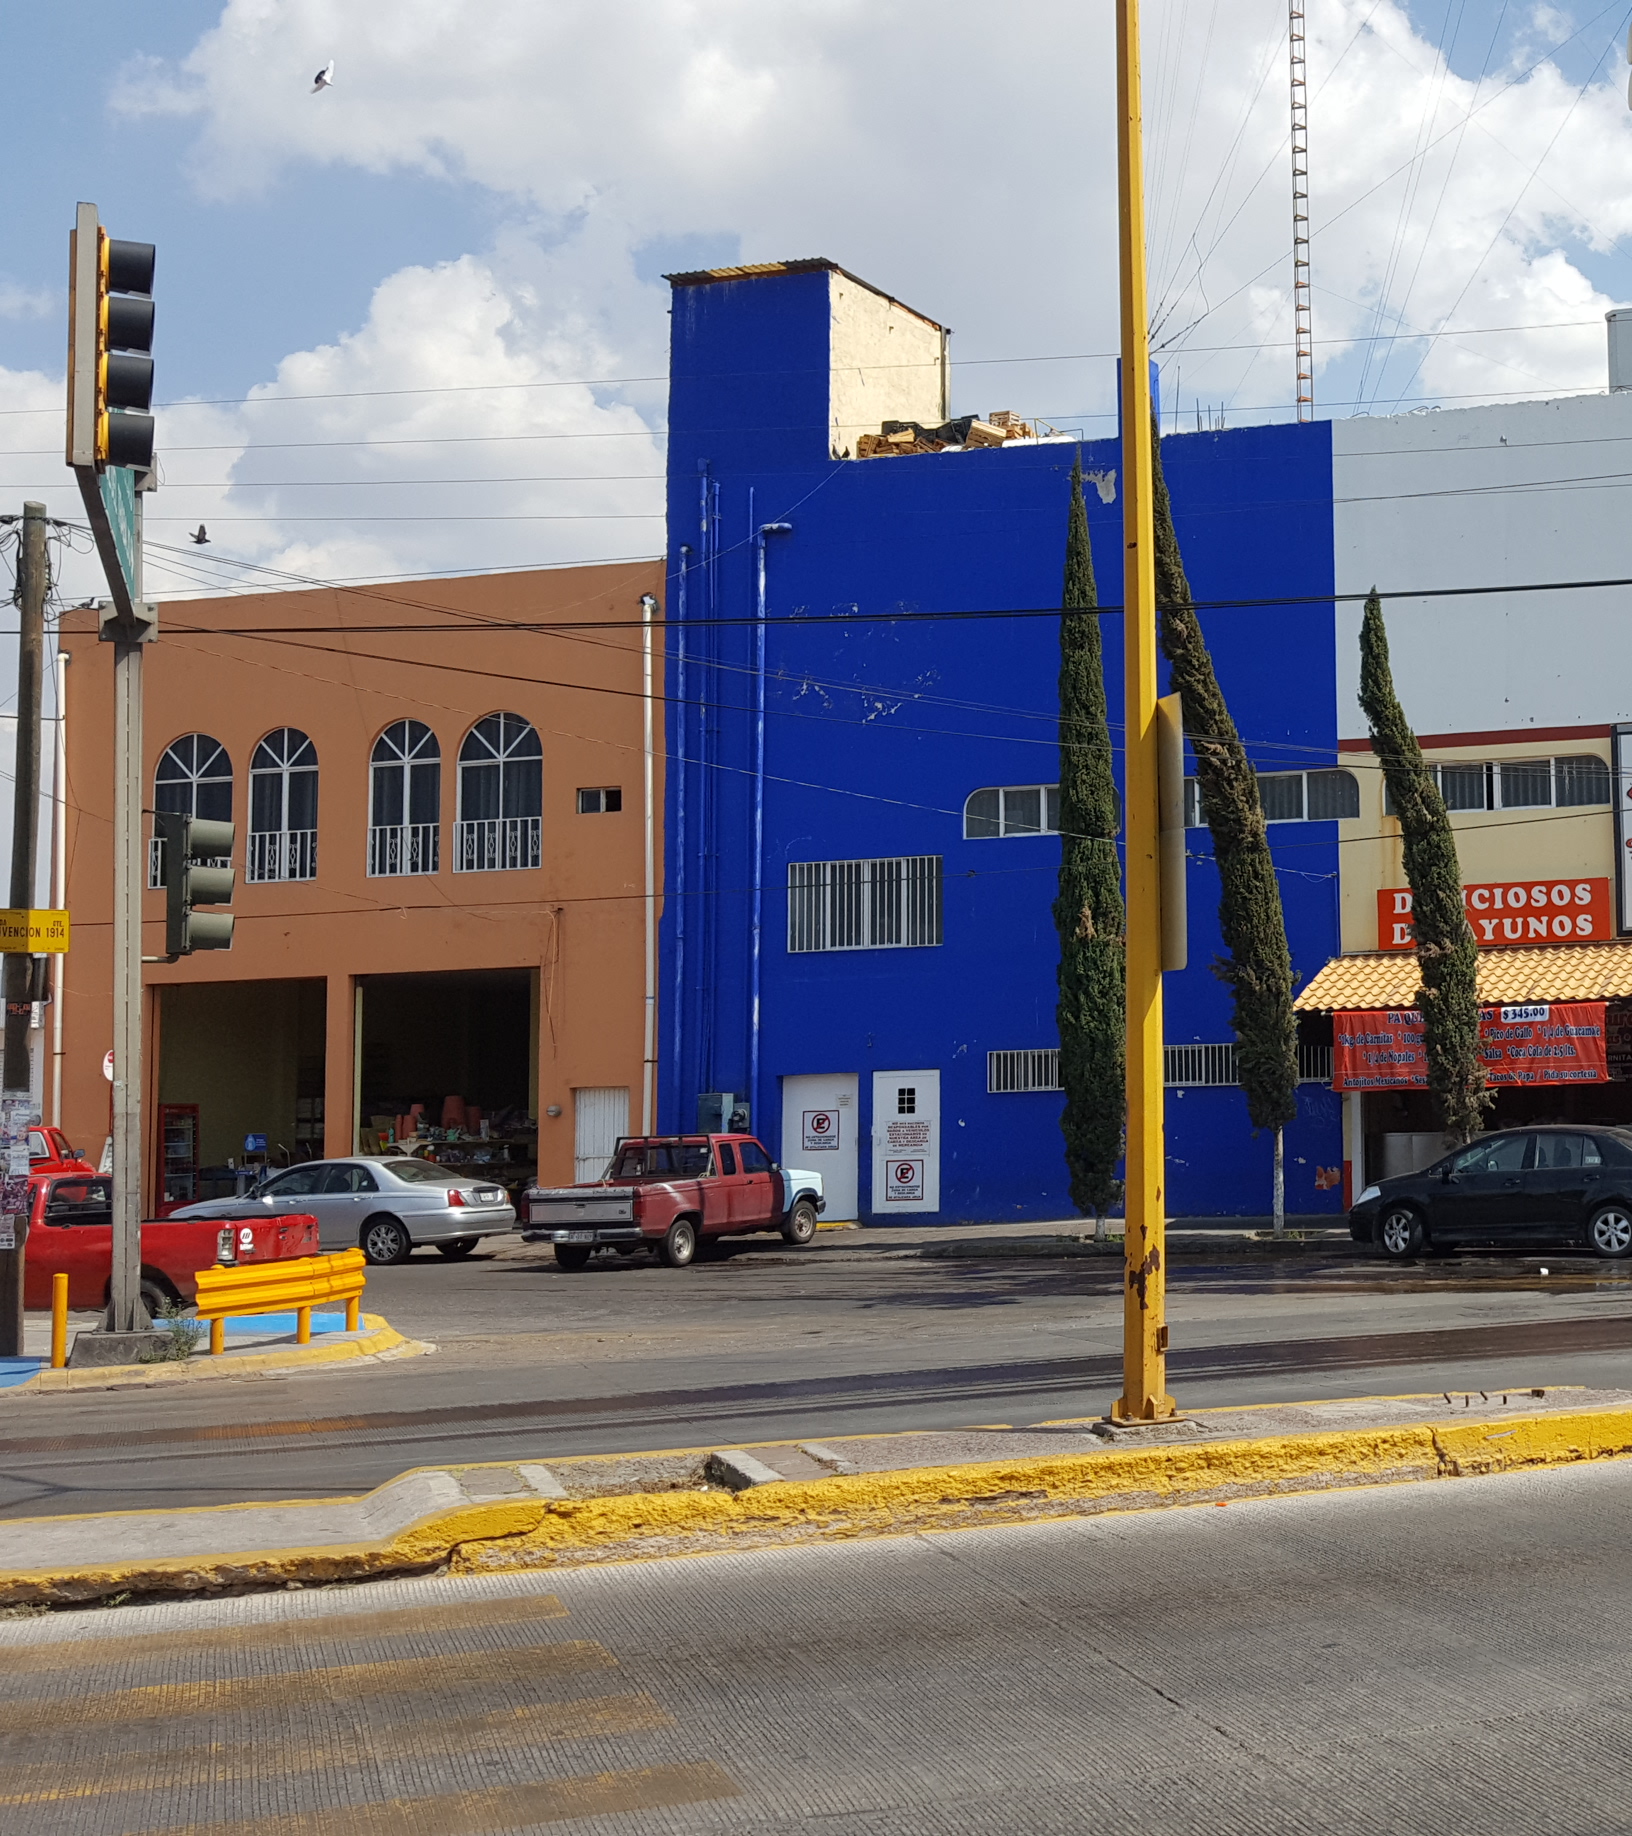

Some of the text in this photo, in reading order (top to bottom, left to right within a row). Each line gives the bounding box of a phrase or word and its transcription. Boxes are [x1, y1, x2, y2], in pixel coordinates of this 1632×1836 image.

[0, 926, 64, 938] VENCION 1914
[1365, 1031, 1394, 1045] Carnitas
[1505, 1027, 1514, 1040] de
[1515, 1026, 1533, 1040] Gallo
[1555, 1024, 1564, 1037] de
[1389, 1050, 1415, 1065] Nopales
[1484, 1047, 1502, 1060] Salsa
[1510, 1045, 1526, 1058] Coca
[1527, 1044, 1542, 1057] Cola
[1543, 1043, 1552, 1057] de
[1343, 1076, 1374, 1088] Antojitos
[1375, 1075, 1408, 1087] Mexicanos
[1488, 1072, 1507, 1082] Tacos
[1517, 1070, 1534, 1082] Papa
[1543, 1069, 1559, 1079] Pida
[1560, 1070, 1568, 1079] su
